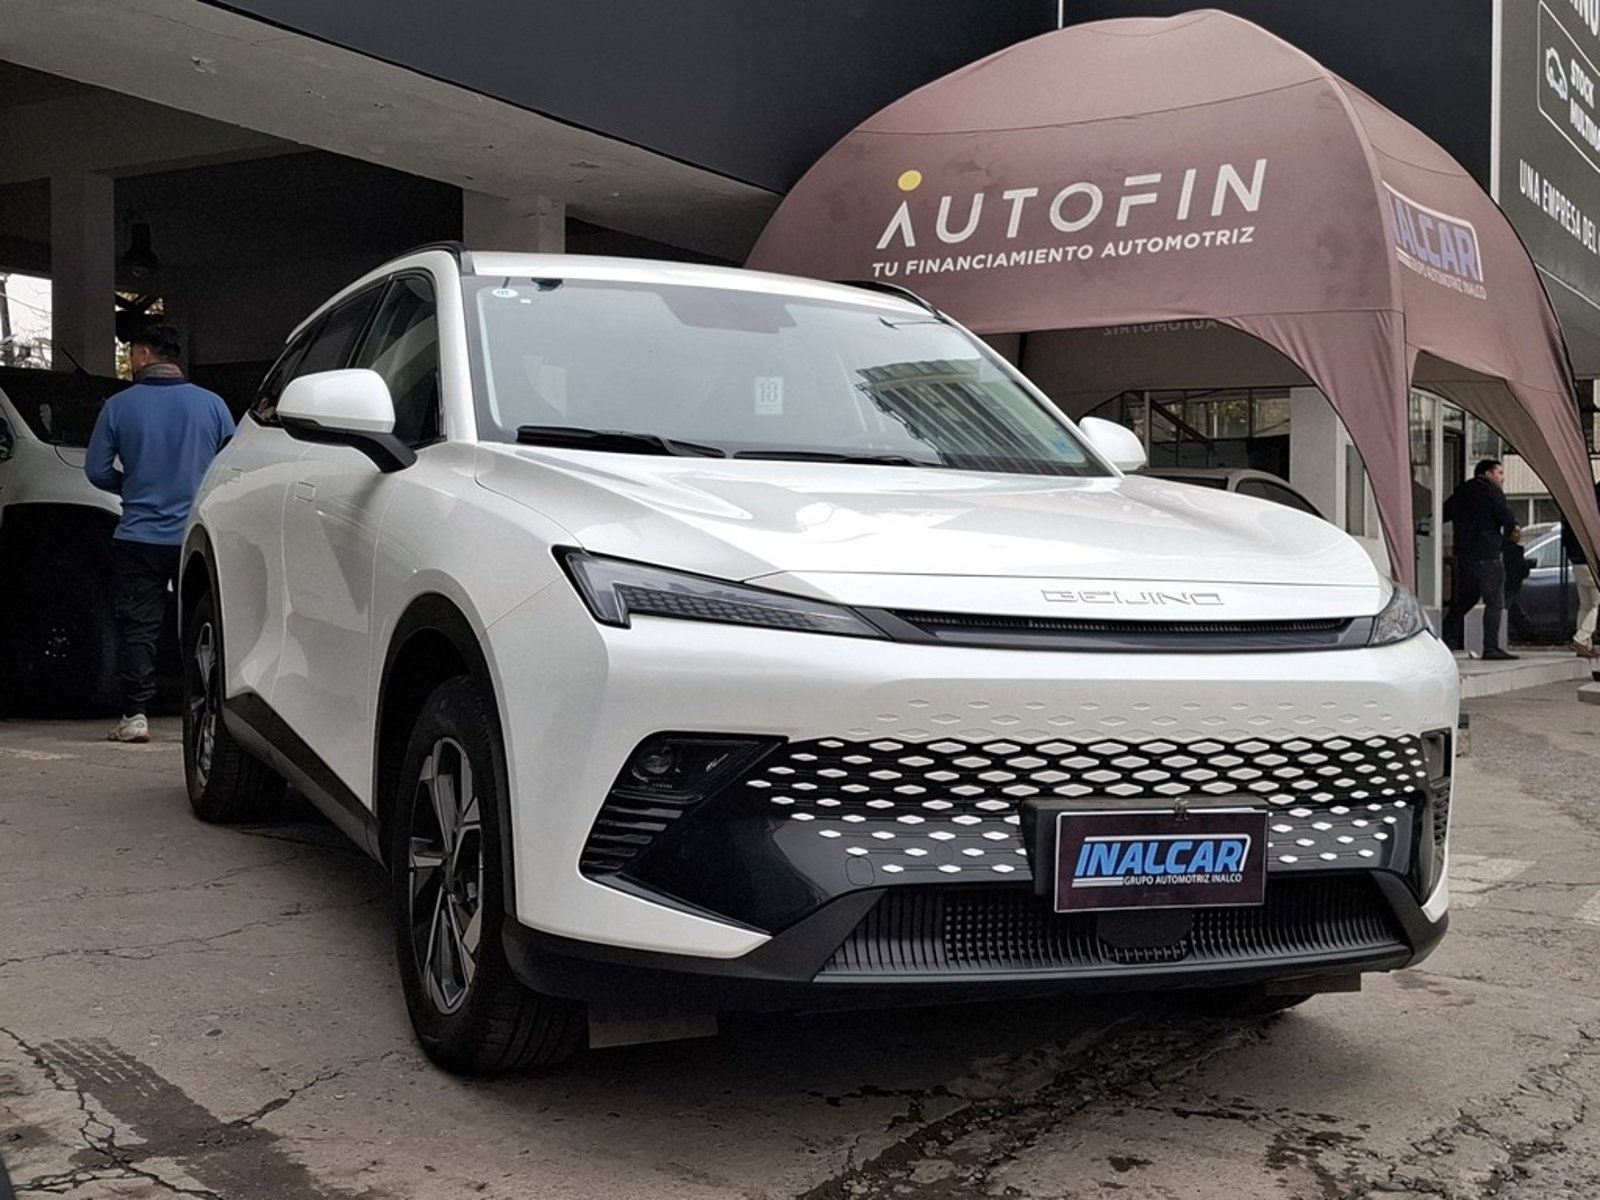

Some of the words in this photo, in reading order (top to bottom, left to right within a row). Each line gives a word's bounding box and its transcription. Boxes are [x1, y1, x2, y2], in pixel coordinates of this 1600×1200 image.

[876, 158, 1268, 249] AUTOFIN
[1519, 158, 1540, 207] UNA
[1542, 178, 1581, 241] EMPRESA
[872, 262, 898, 278] TU
[905, 245, 1094, 276] FINANCIAMIENTO
[1101, 226, 1256, 258] AUTOMOTRIZ
[1385, 190, 1480, 281] ALCAR
[1074, 840, 1243, 877] INALCAR
[1124, 875, 1154, 886] GRUPO
[1155, 874, 1210, 885] AUTOMOTRIZ
[1211, 873, 1243, 884] INALCO
